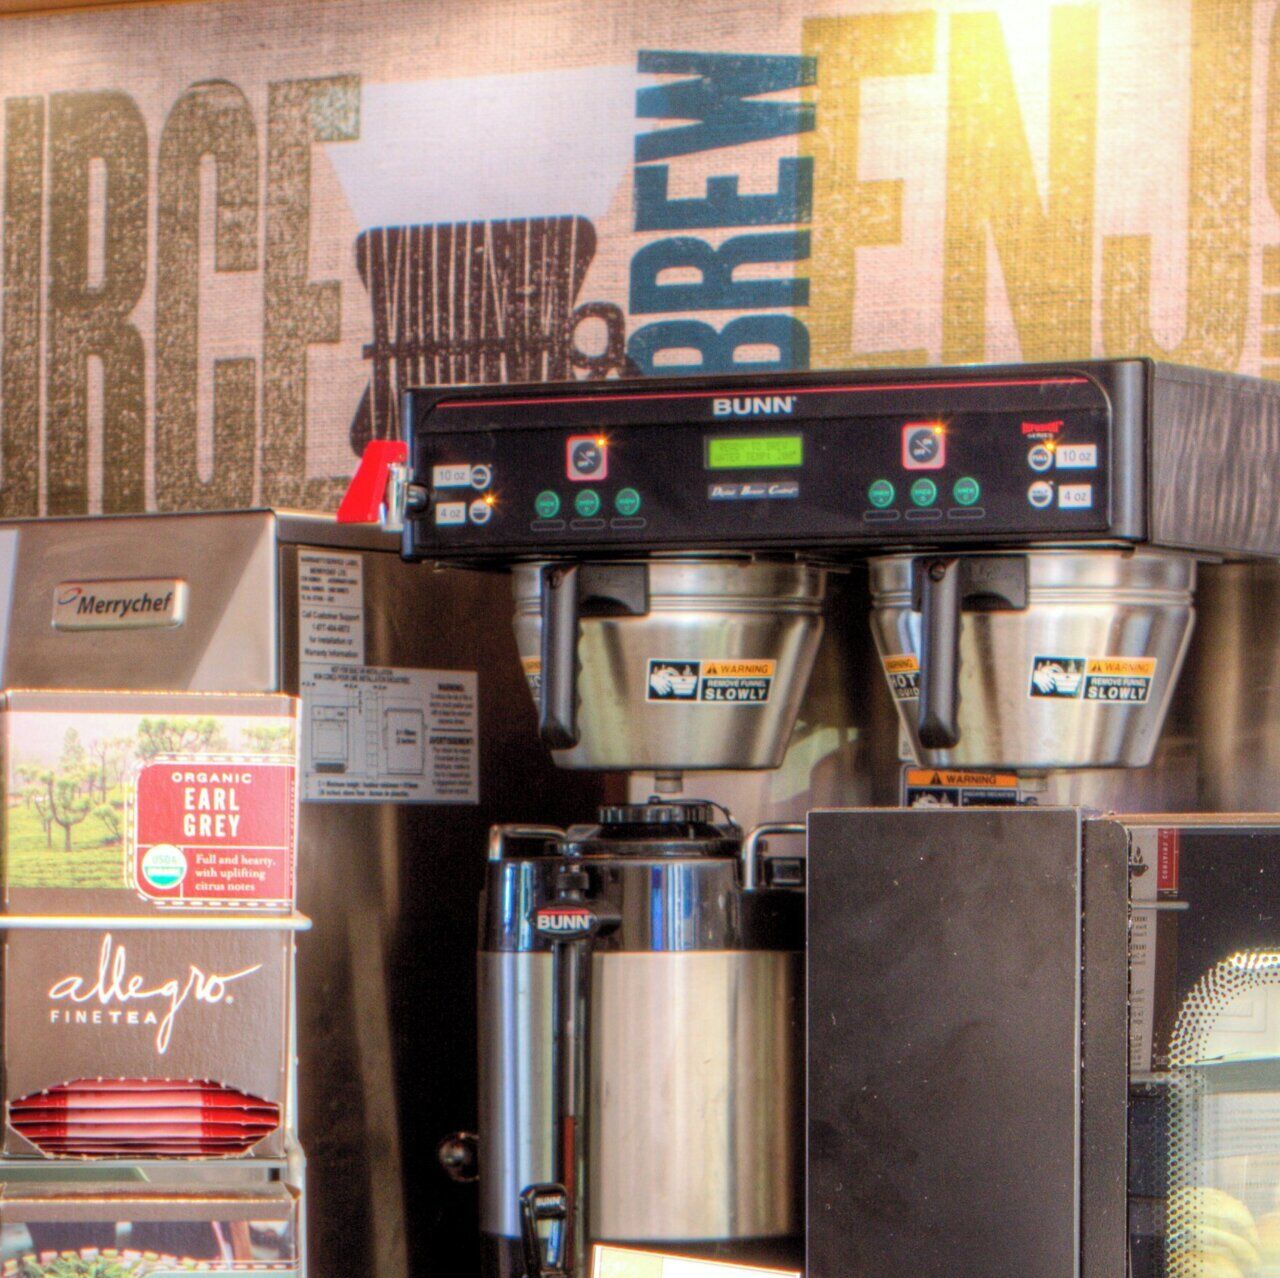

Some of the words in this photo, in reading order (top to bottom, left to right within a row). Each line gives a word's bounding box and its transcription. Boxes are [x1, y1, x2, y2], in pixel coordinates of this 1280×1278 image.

[628, 50, 818, 374] BREW
[713, 396, 793, 416] BUNN
[1062, 450, 1077, 462] 10
[1078, 452, 1093, 463] oz
[439, 469, 453, 482] 10
[453, 472, 466, 482] oz
[1064, 488, 1073, 501] 4
[1074, 491, 1088, 502] oz
[439, 507, 449, 520] 4
[449, 509, 462, 520] oz
[76, 591, 174, 619] Merrychef
[720, 664, 769, 675] WARNING
[1104, 662, 1151, 674] WARNING
[705, 687, 767, 701] SLOWLY
[1087, 686, 1146, 700] SLOWLY
[171, 771, 253, 785] ORGANIC
[947, 774, 997, 786] WARNING
[184, 786, 241, 812] EARL
[183, 813, 242, 838] GREY
[537, 914, 591, 931] BUNN
